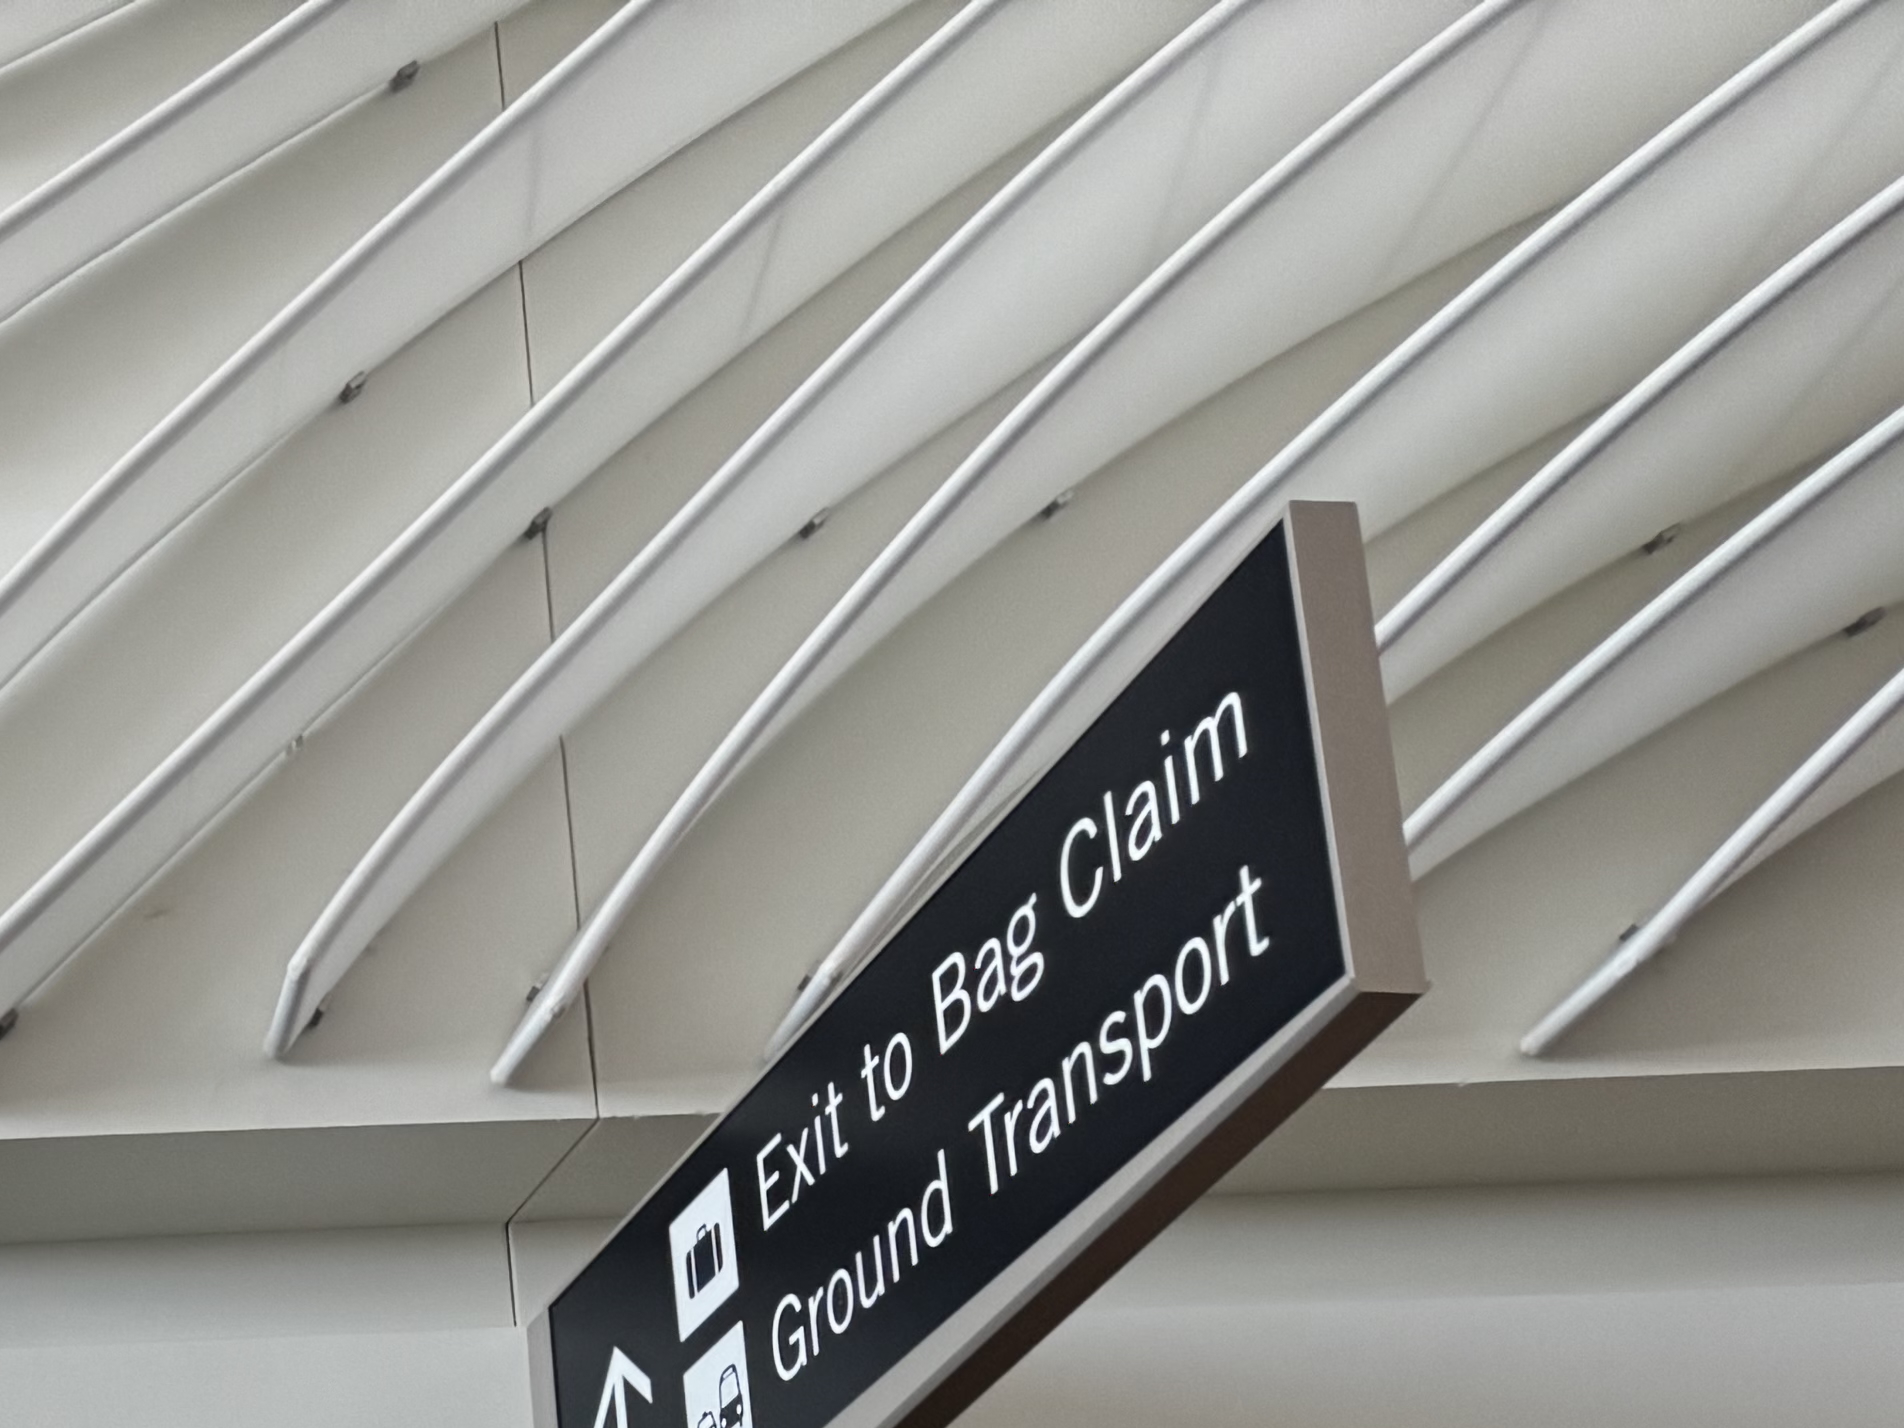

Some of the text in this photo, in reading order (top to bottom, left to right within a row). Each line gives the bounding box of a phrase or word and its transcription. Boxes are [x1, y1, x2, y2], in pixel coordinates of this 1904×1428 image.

[757, 692, 1247, 1230] Exit to Bag Claim
[773, 866, 1269, 1381] Ground Transport
